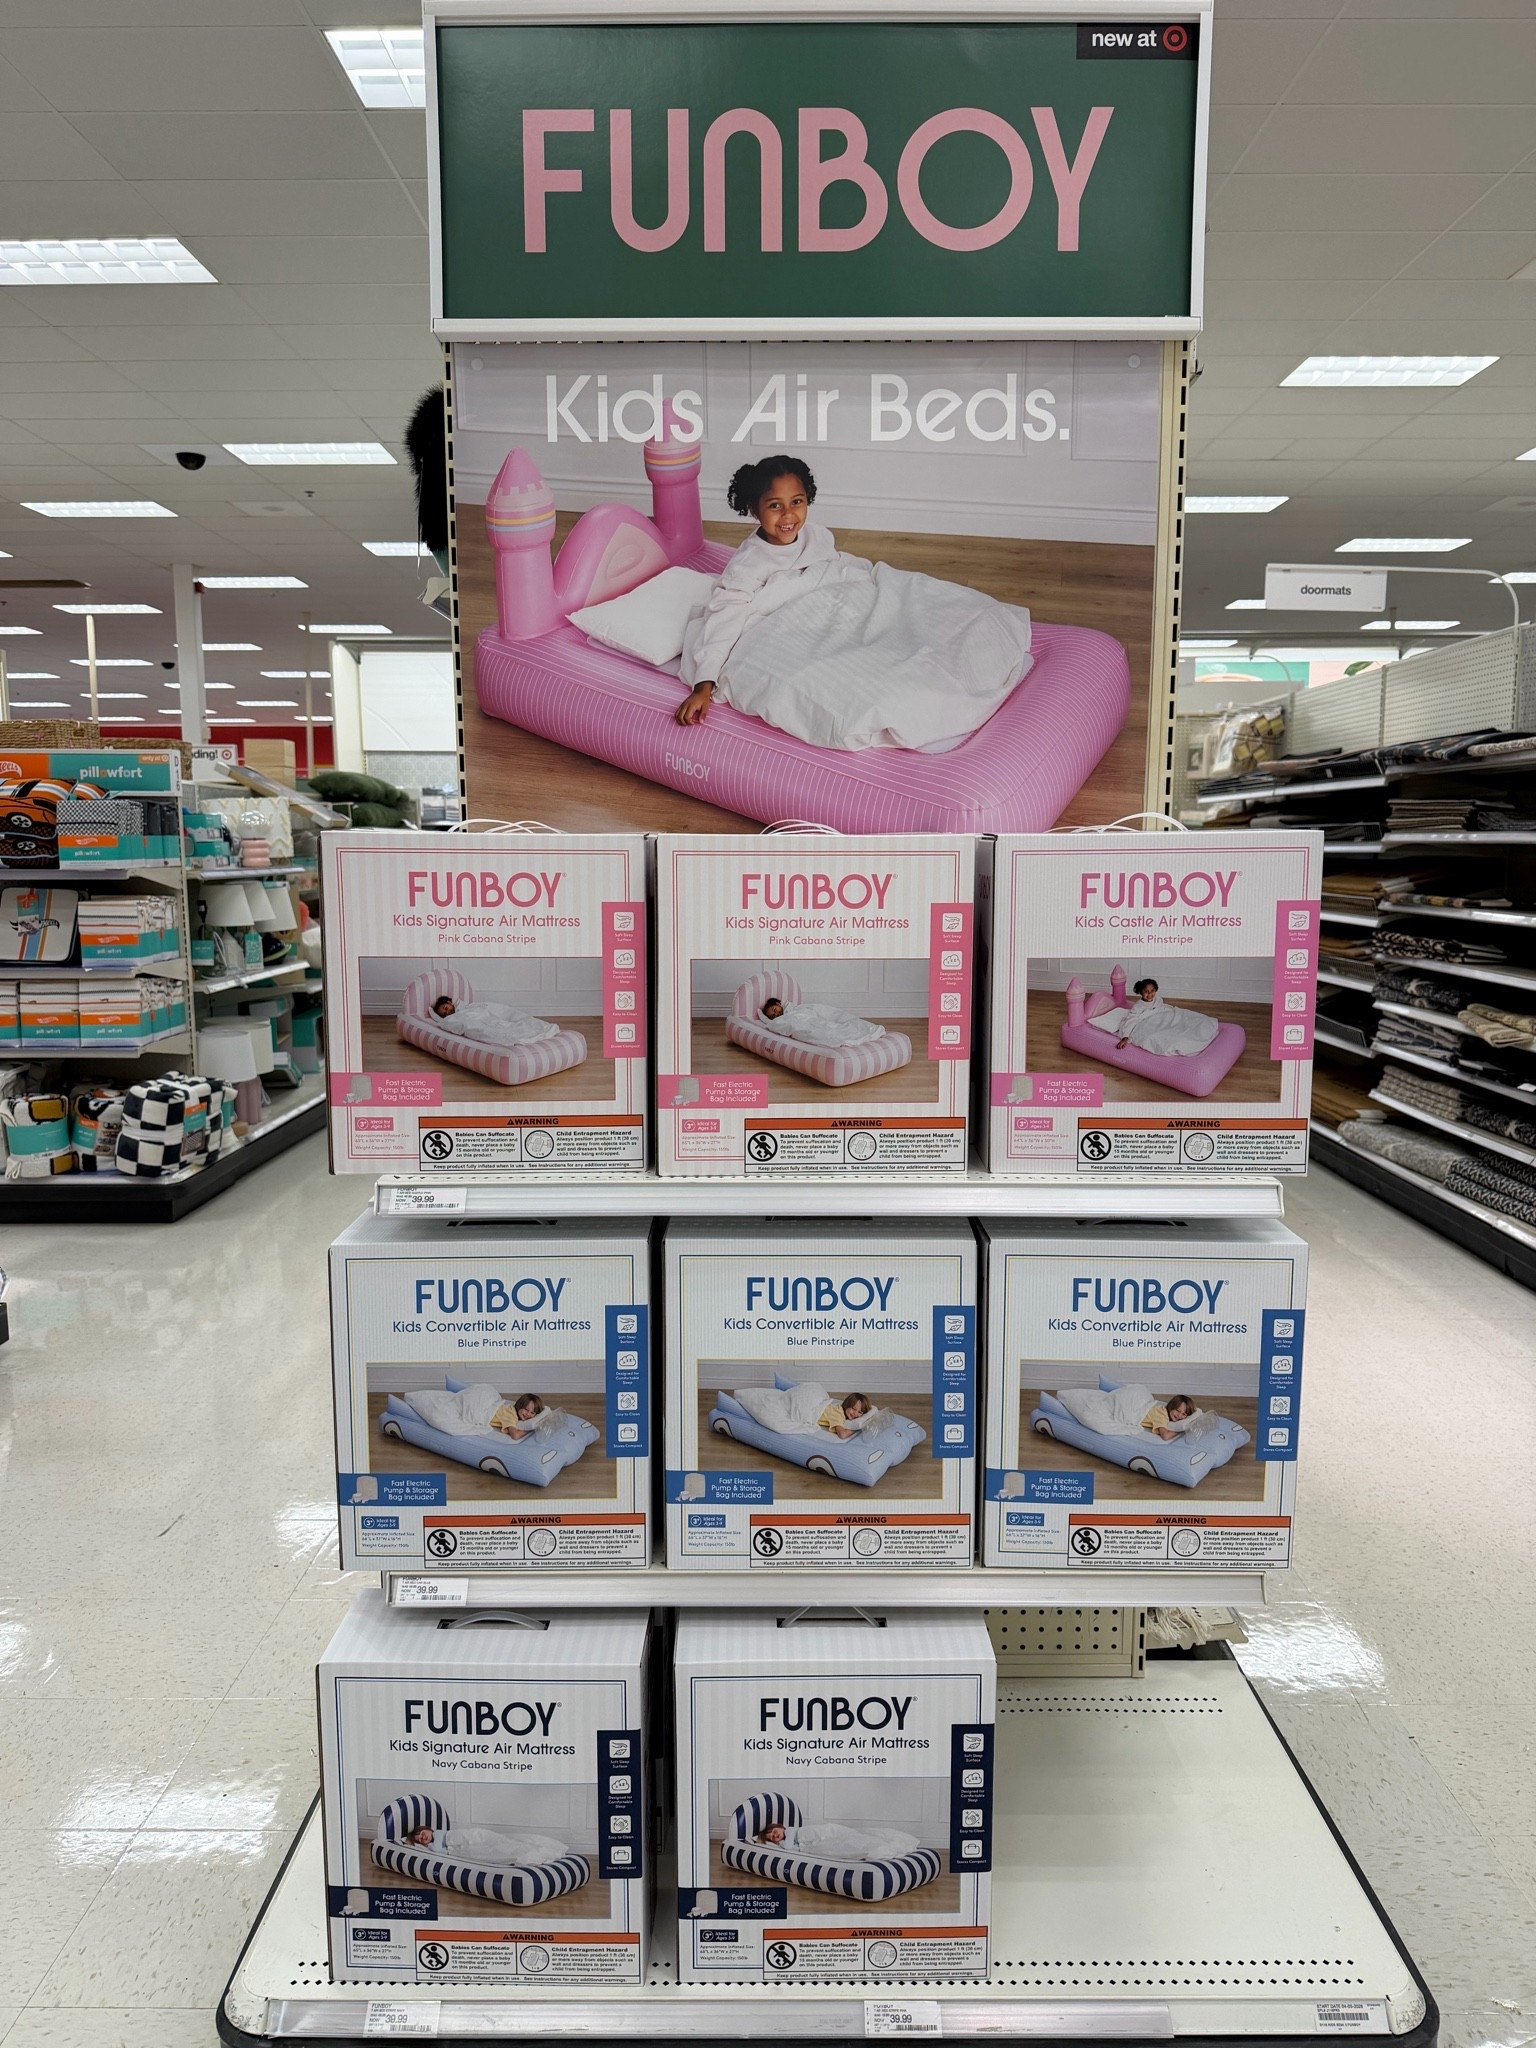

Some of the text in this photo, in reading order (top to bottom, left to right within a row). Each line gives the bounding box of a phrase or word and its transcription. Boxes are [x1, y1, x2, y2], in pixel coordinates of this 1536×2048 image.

[1092, 30, 1157, 47] new at
[522, 107, 1114, 253] FUNBOY
[546, 374, 1070, 443] Kids Air Beds.
[1300, 584, 1352, 596] doormats
[80, 766, 143, 780] pillowfort
[666, 752, 710, 782] FUNBOY
[409, 872, 561, 907] FUNBOY
[742, 874, 892, 909] FUNBOY
[1081, 872, 1237, 908] FUNBOY
[393, 914, 580, 929] Kids Signature Air Mattress
[726, 917, 909, 931] Kids Signature Air Mattress
[1076, 915, 1241, 927] Kids Castle Air Mattress
[439, 934, 536, 944] Pink Cabana Stripe
[770, 936, 865, 946] Pink Cabana Stripe
[1122, 935, 1193, 946] Pink Pinstripe
[412, 1195, 434, 1203] 39.99
[416, 1278, 569, 1313] FUNBOY
[747, 1277, 894, 1311] FUNBOY
[1073, 1278, 1227, 1314] FUNBOY
[393, 1319, 590, 1332] Kids Convertible Air Mattress
[724, 1318, 918, 1330] Kids Convertible Air Mattress
[1049, 1319, 1247, 1333] Kids Convertible Air Mattress
[458, 1339, 526, 1348] Blue Pinstripe
[787, 1337, 854, 1347] Blue Pinstripe
[1113, 1339, 1181, 1349] Blue Pinstripe
[416, 1586, 438, 1594] 39.99
[405, 1700, 556, 1736] FUNBOY
[761, 1697, 915, 1731] FUNBOY
[390, 1740, 575, 1755] Kids Signature Air Mattress
[744, 1737, 929, 1752] Kids Signature Air Mattress
[432, 1759, 532, 1771] Navy Cabana Stripe
[786, 1755, 887, 1767] Navy Cabana Stripe
[858, 1929, 903, 1937] WARNING
[890, 2014, 912, 2023] 39.99
